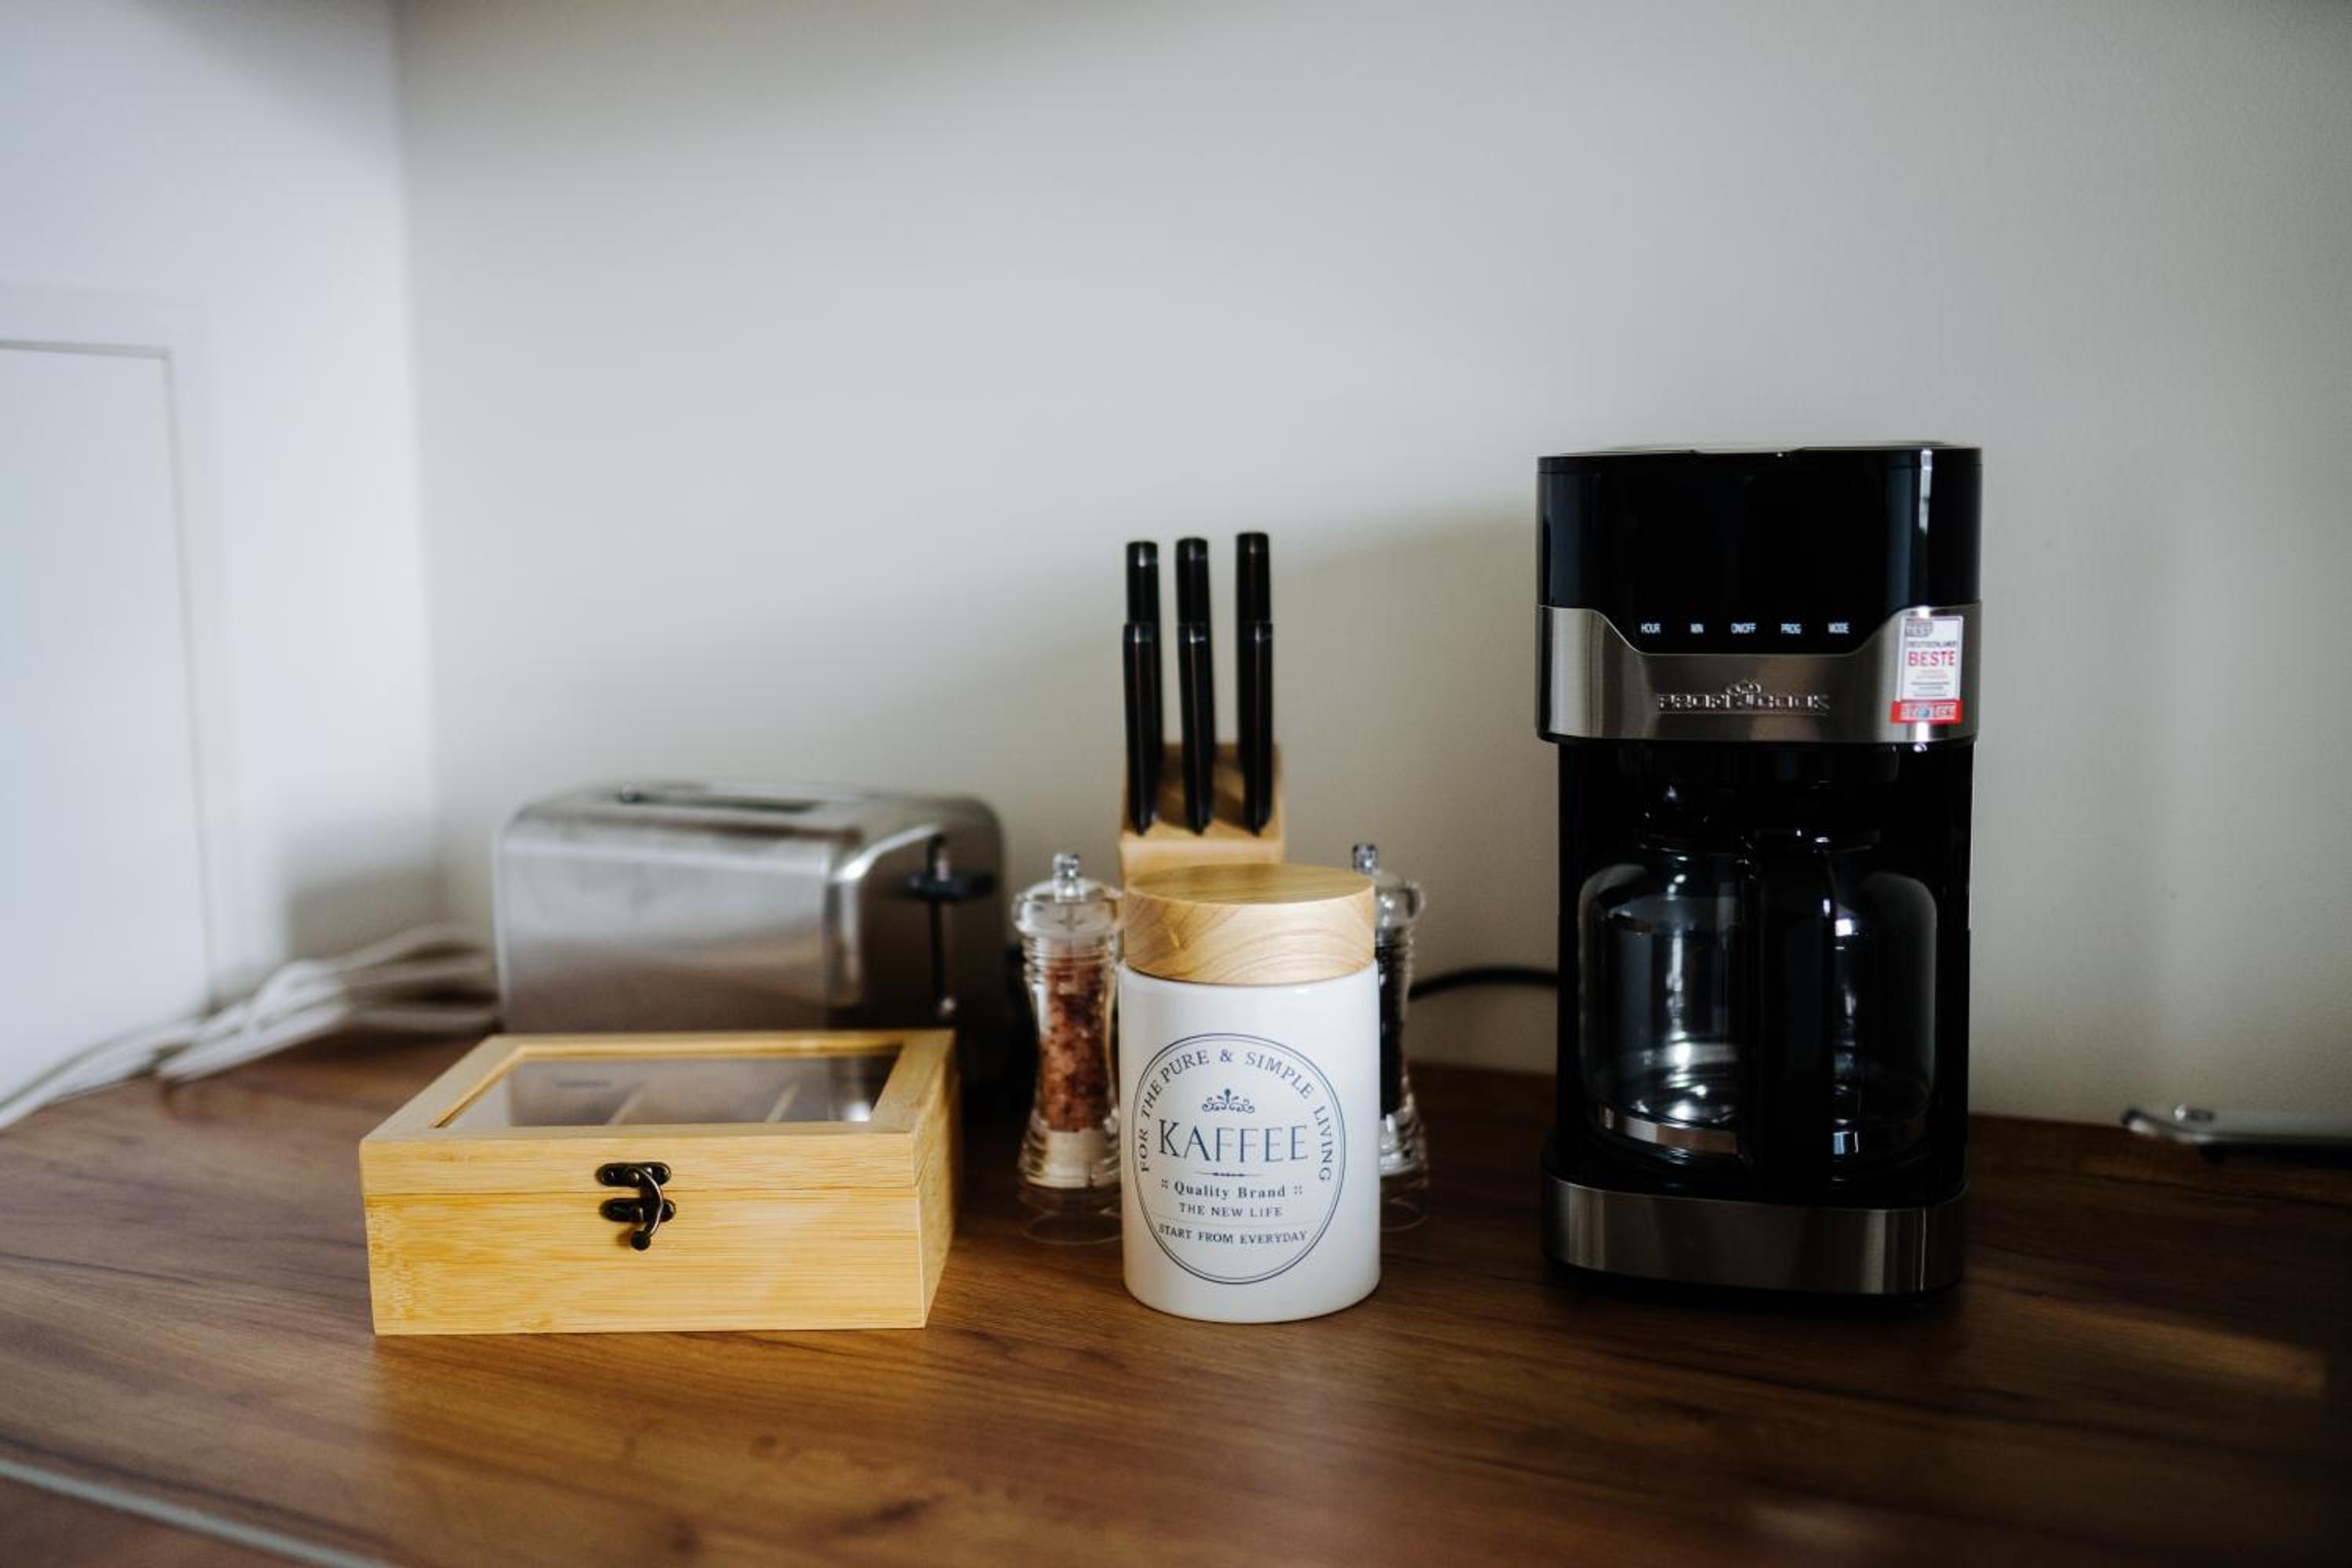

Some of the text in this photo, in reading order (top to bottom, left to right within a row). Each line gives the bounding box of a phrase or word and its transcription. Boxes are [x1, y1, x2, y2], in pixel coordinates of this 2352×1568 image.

[1641, 623, 1661, 633] HOUR
[1907, 652, 1955, 666] BESTE
[1140, 1049, 1332, 1181] FOR THE PURE & SIMPLE LIVING
[1158, 1119, 1309, 1163] KAFFEE
[1174, 1181, 1286, 1200] Quality Brand
[1178, 1203, 1282, 1217] THE NEW LIFE
[1160, 1223, 1308, 1244] START FROM EVERYDAY
